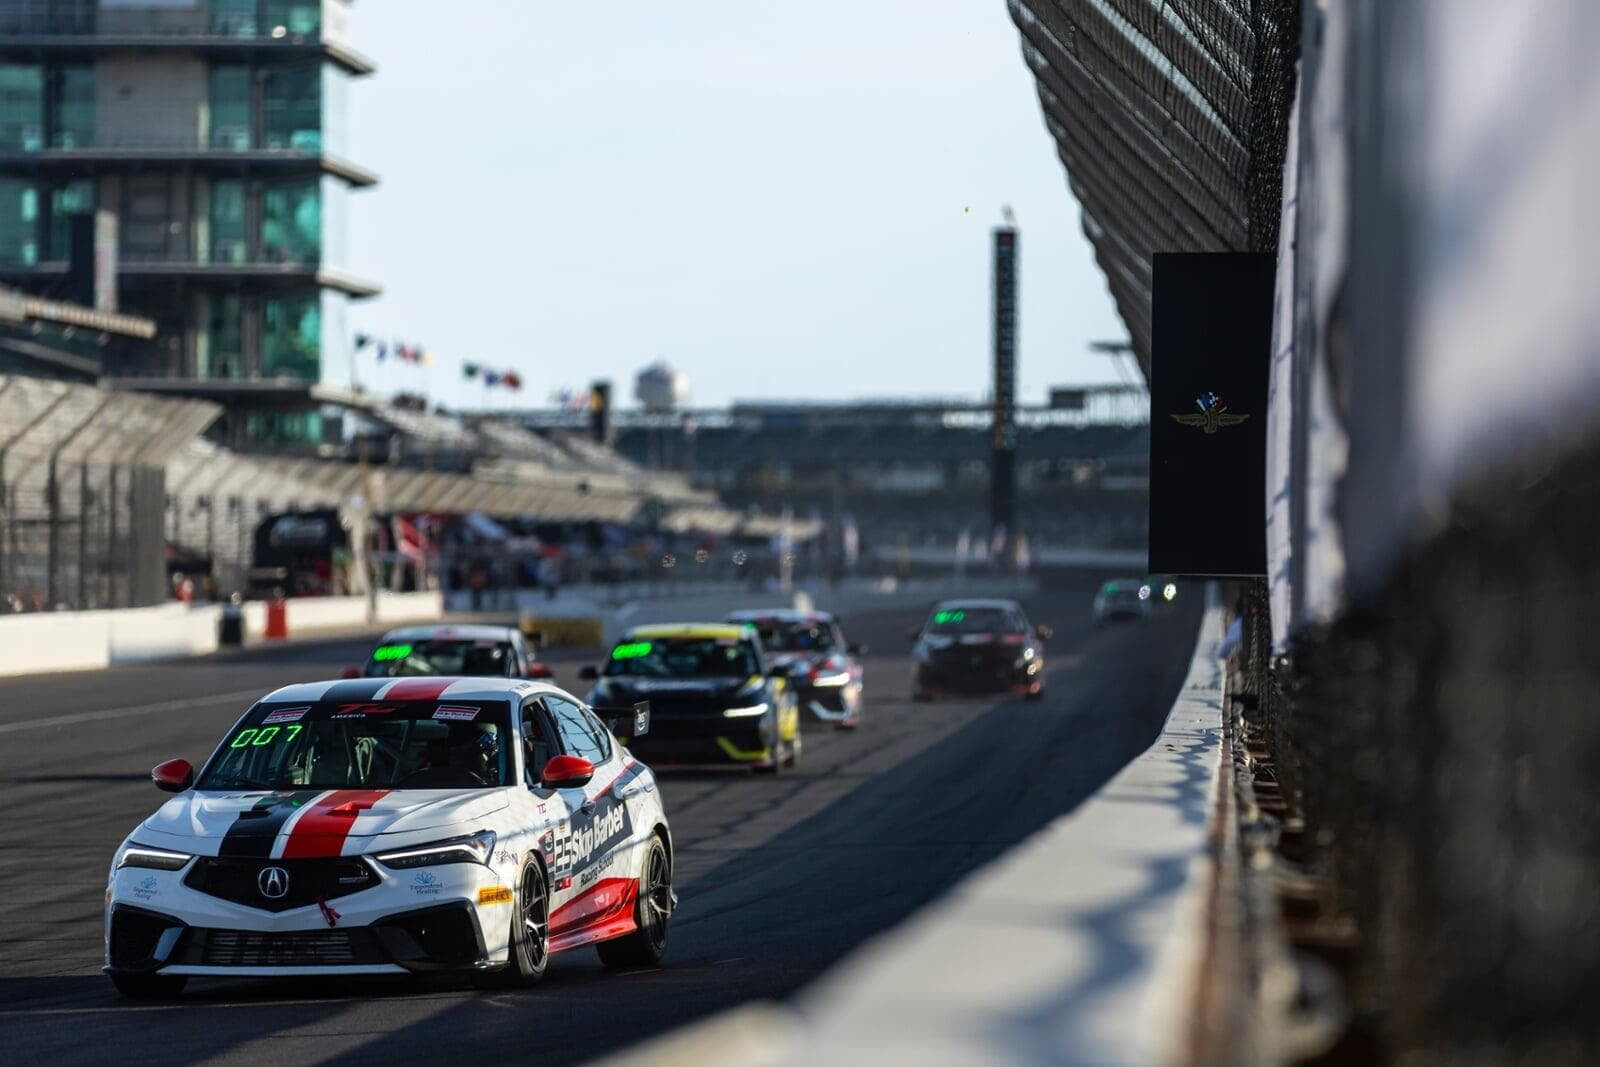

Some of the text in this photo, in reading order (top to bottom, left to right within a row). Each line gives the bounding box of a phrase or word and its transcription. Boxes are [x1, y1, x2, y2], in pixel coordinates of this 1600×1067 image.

[230, 725, 303, 748] 007
[571, 824, 593, 865] Skip
[593, 803, 624, 850] Barber
[580, 866, 598, 888] Racing
